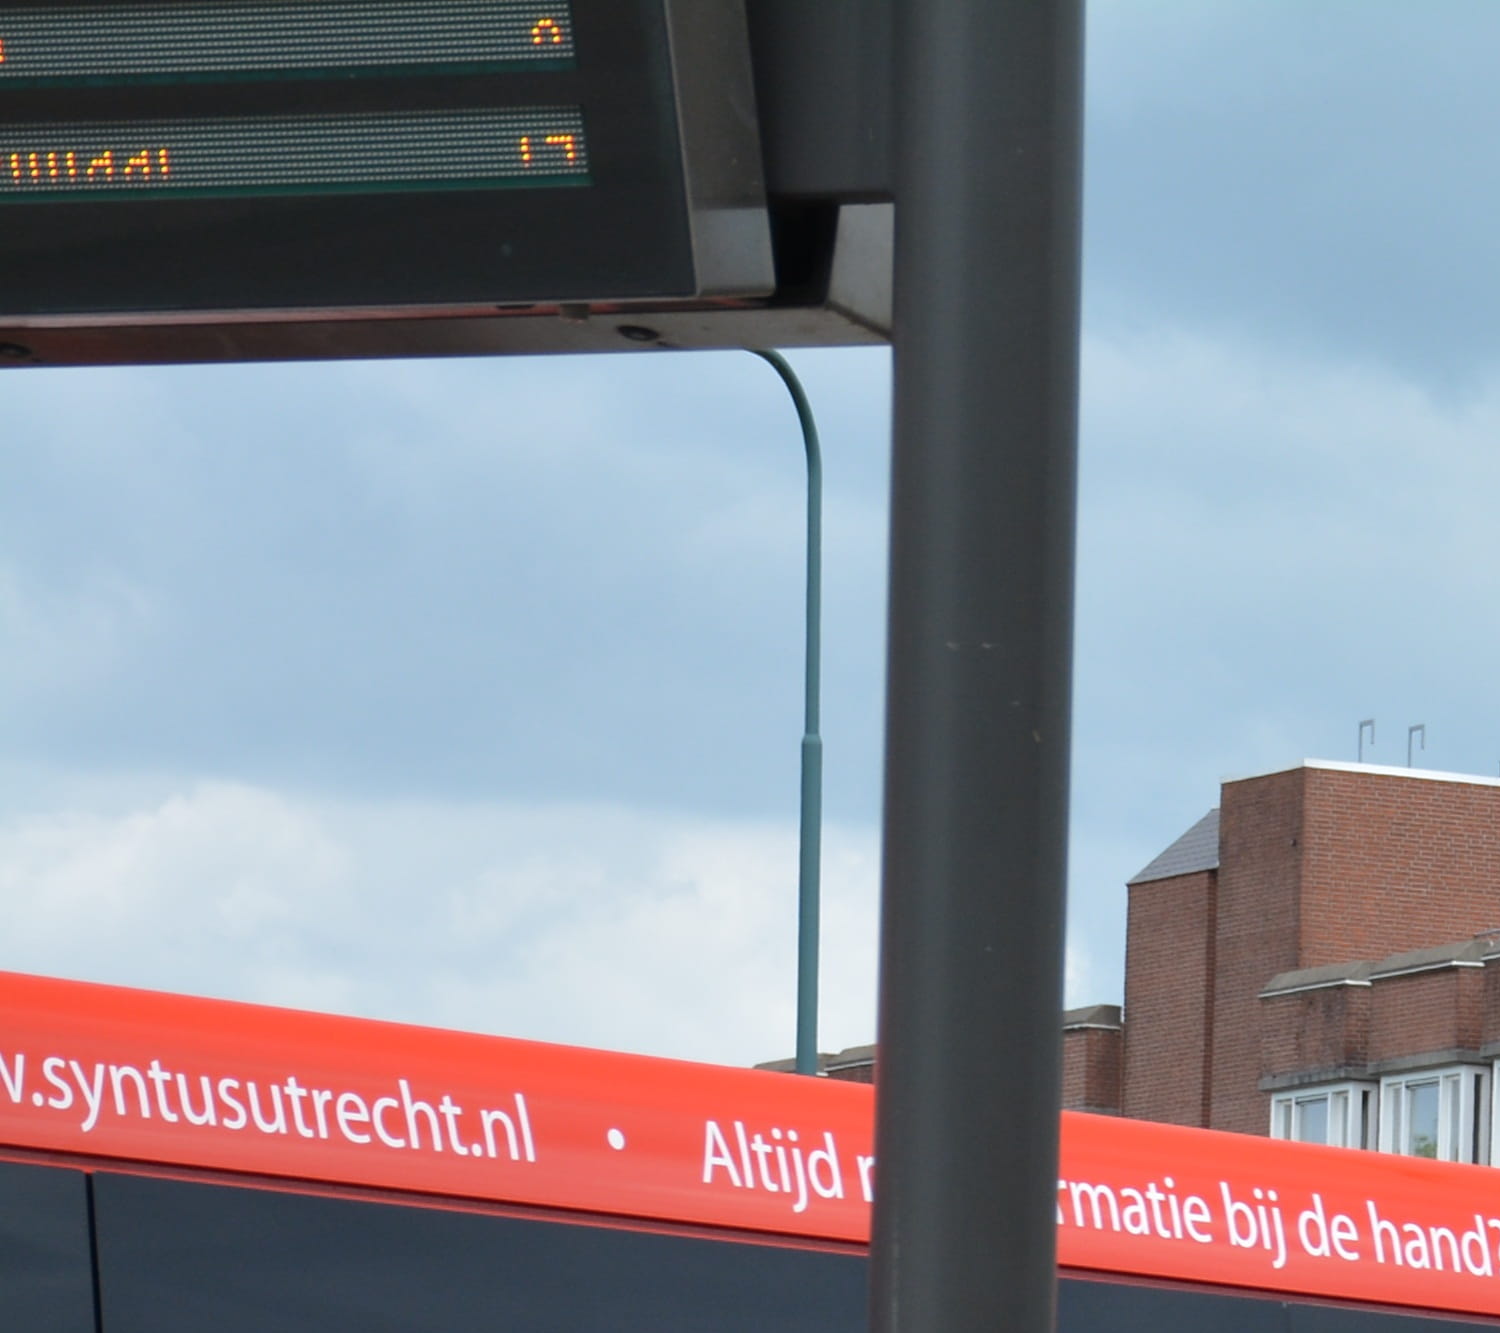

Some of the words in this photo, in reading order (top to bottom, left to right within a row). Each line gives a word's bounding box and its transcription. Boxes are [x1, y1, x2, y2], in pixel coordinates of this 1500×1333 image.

[703, 1120, 843, 1213] Altijd
[1220, 1181, 1287, 1269] bij
[1298, 1193, 1360, 1261] de
